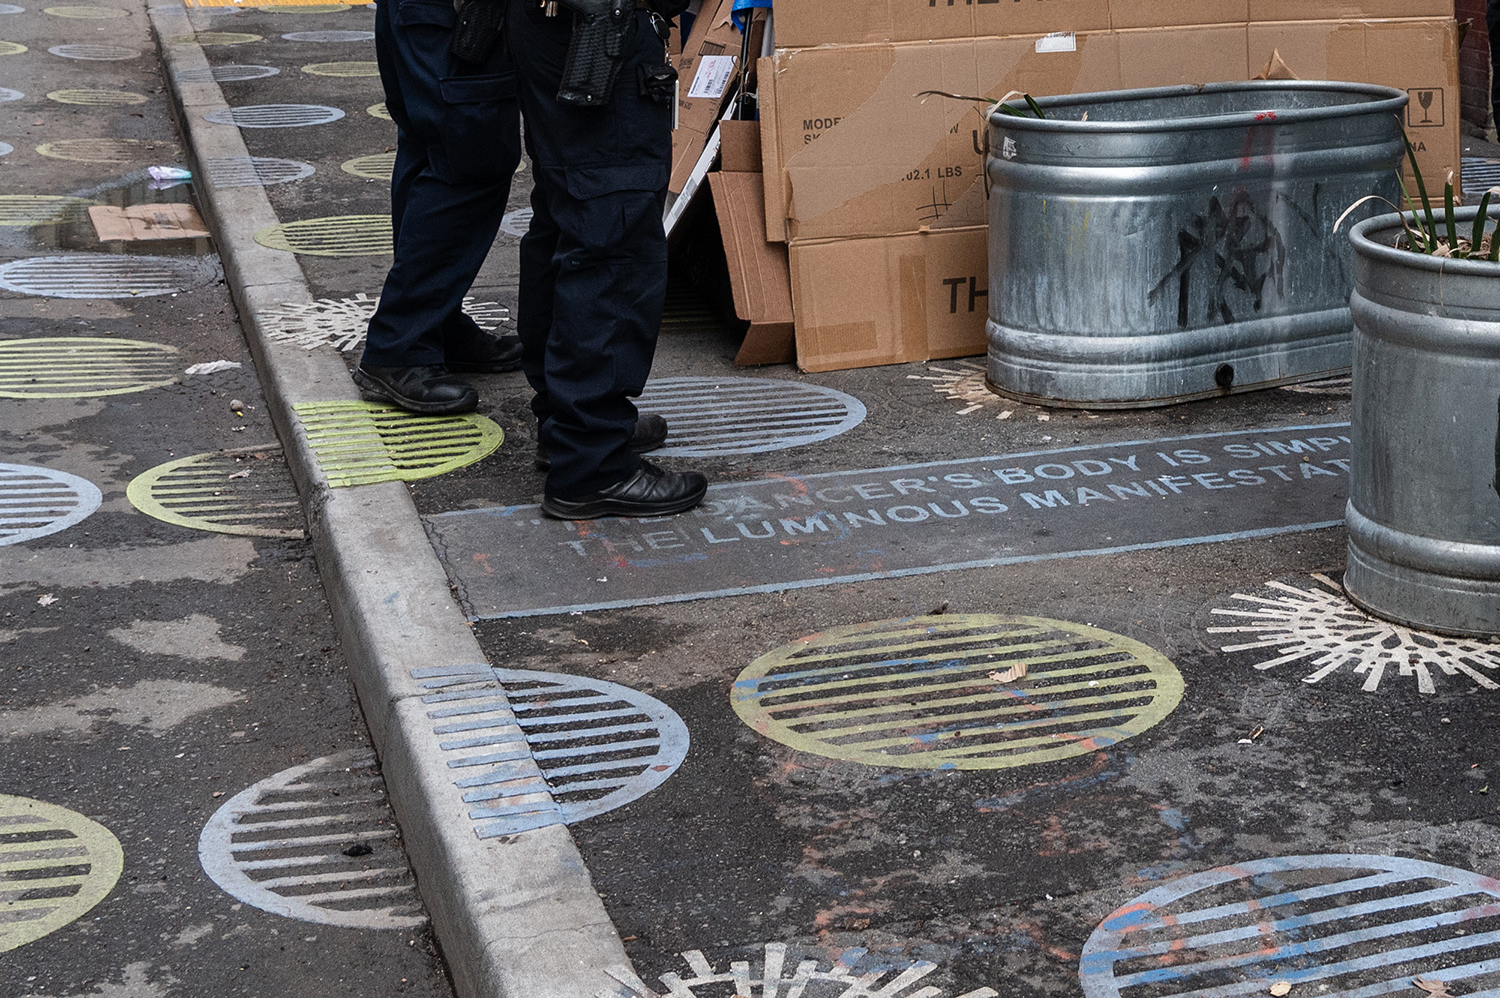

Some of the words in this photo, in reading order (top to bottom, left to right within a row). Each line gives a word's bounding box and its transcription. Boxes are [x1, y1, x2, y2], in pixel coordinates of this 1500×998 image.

[802, 116, 846, 131] MODE
[900, 168, 931, 181] 02.1
[937, 165, 963, 179] LBS
[991, 453, 1142, 486] BODY
[1157, 448, 1212, 468] IS
[700, 496, 1009, 544] LUMINOUS
[1020, 458, 1351, 510] MANIFESTAT
